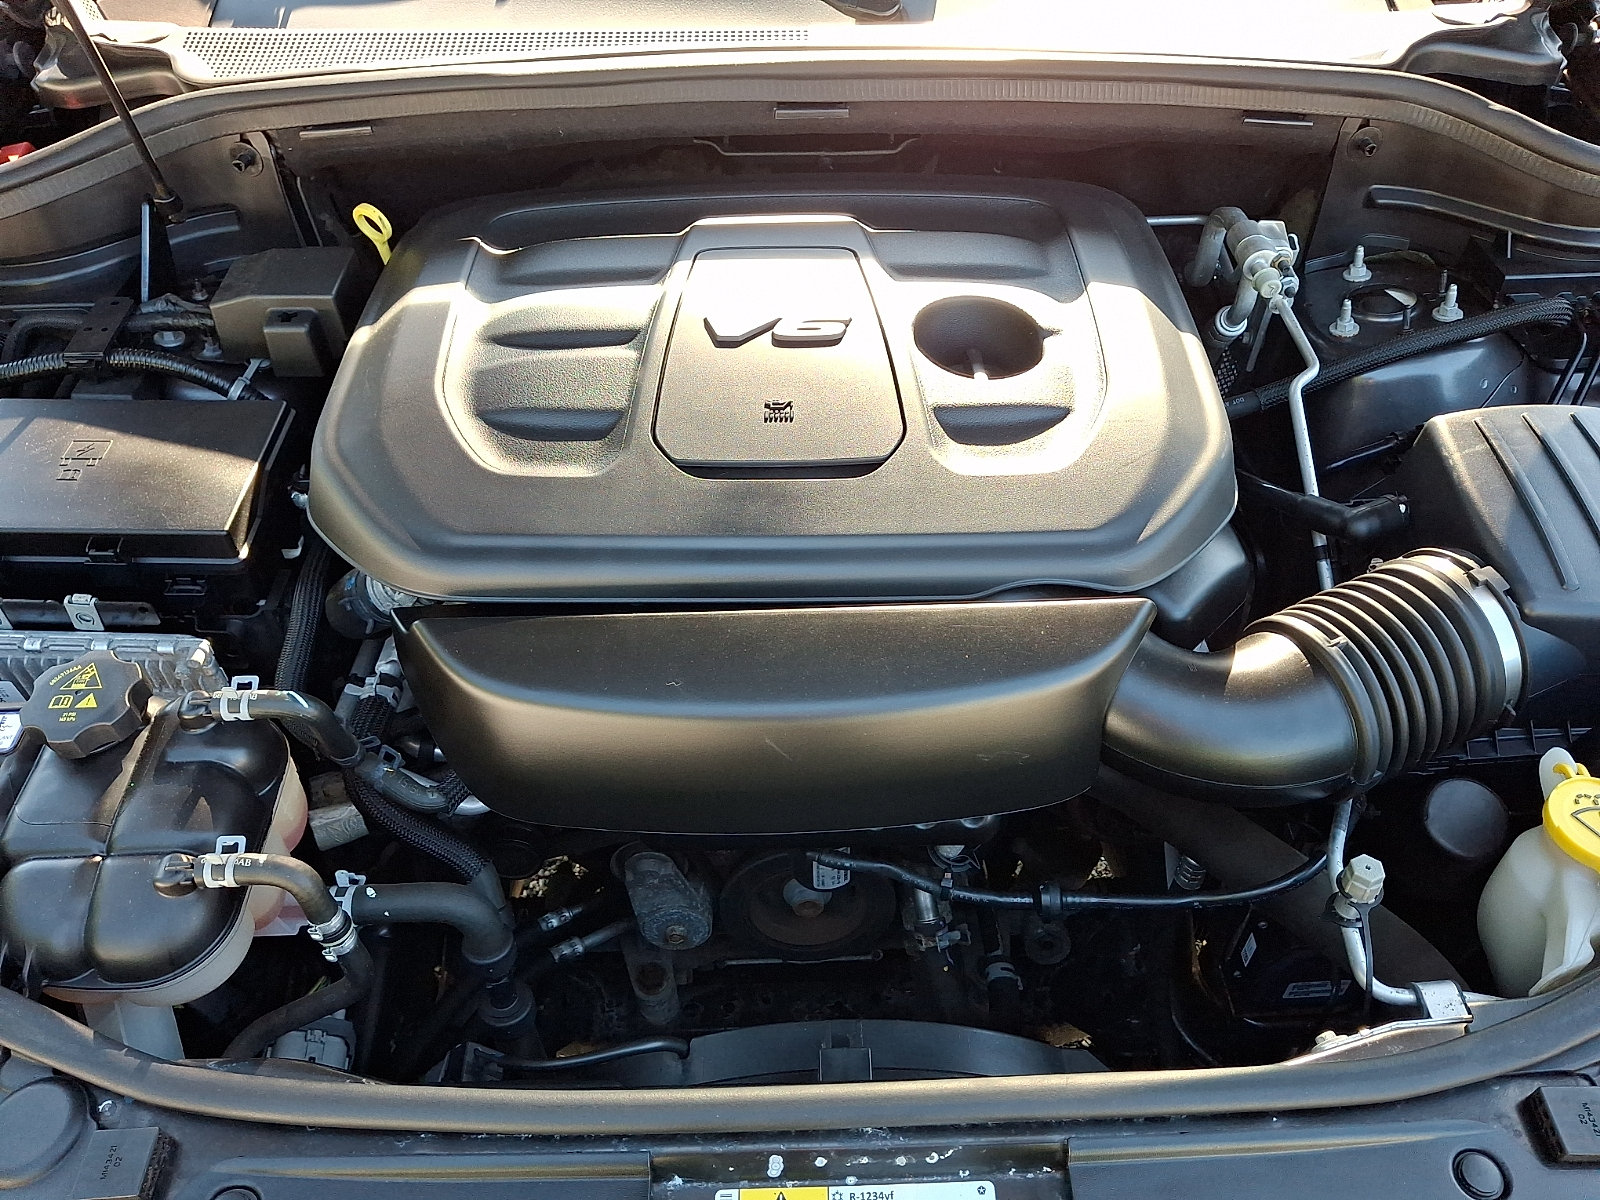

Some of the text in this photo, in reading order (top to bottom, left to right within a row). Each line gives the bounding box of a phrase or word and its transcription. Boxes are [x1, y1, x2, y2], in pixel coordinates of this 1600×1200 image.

[703, 314, 853, 349] V6
[1578, 1113, 1588, 1125] 02
[113, 1157, 123, 1168] 02
